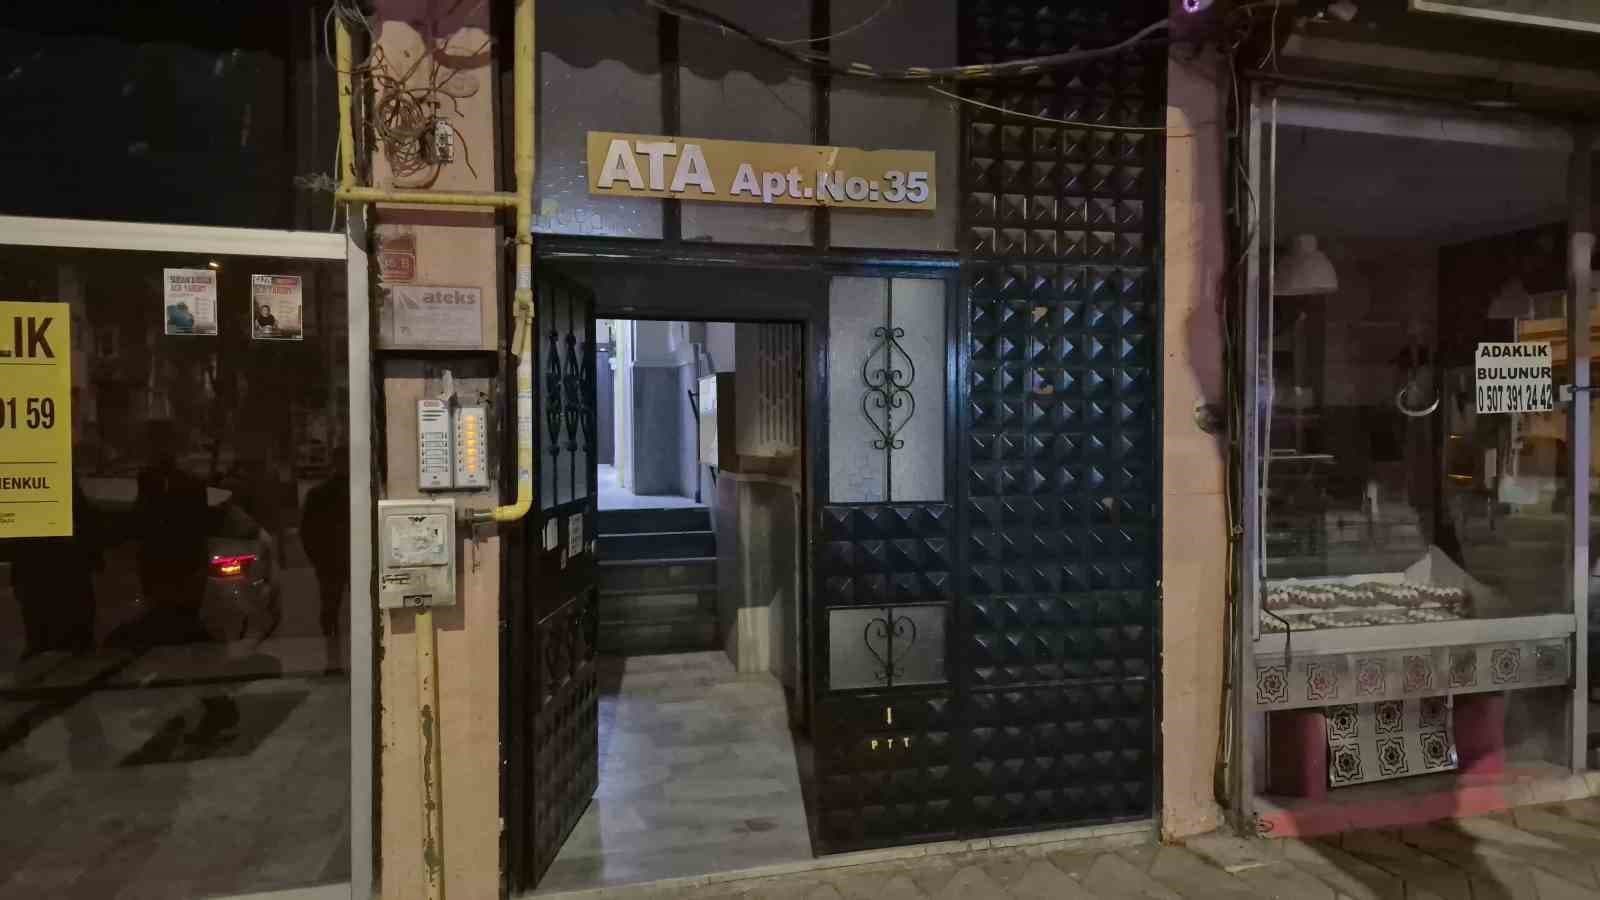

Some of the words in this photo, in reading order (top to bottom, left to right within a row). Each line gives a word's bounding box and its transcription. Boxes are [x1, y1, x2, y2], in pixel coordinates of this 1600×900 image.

[597, 139, 716, 194] ATA
[1480, 345, 1548, 357] ADAKLIK
[1477, 367, 1552, 380] BULUNUR
[1478, 385, 1484, 412] 0
[1486, 385, 1503, 411] 507
[1506, 384, 1523, 411] 391
[1526, 384, 1538, 410] 24
[1540, 383, 1553, 410] 42
[26, 397, 55, 429] 59
[0, 476, 51, 489] ENKUL
